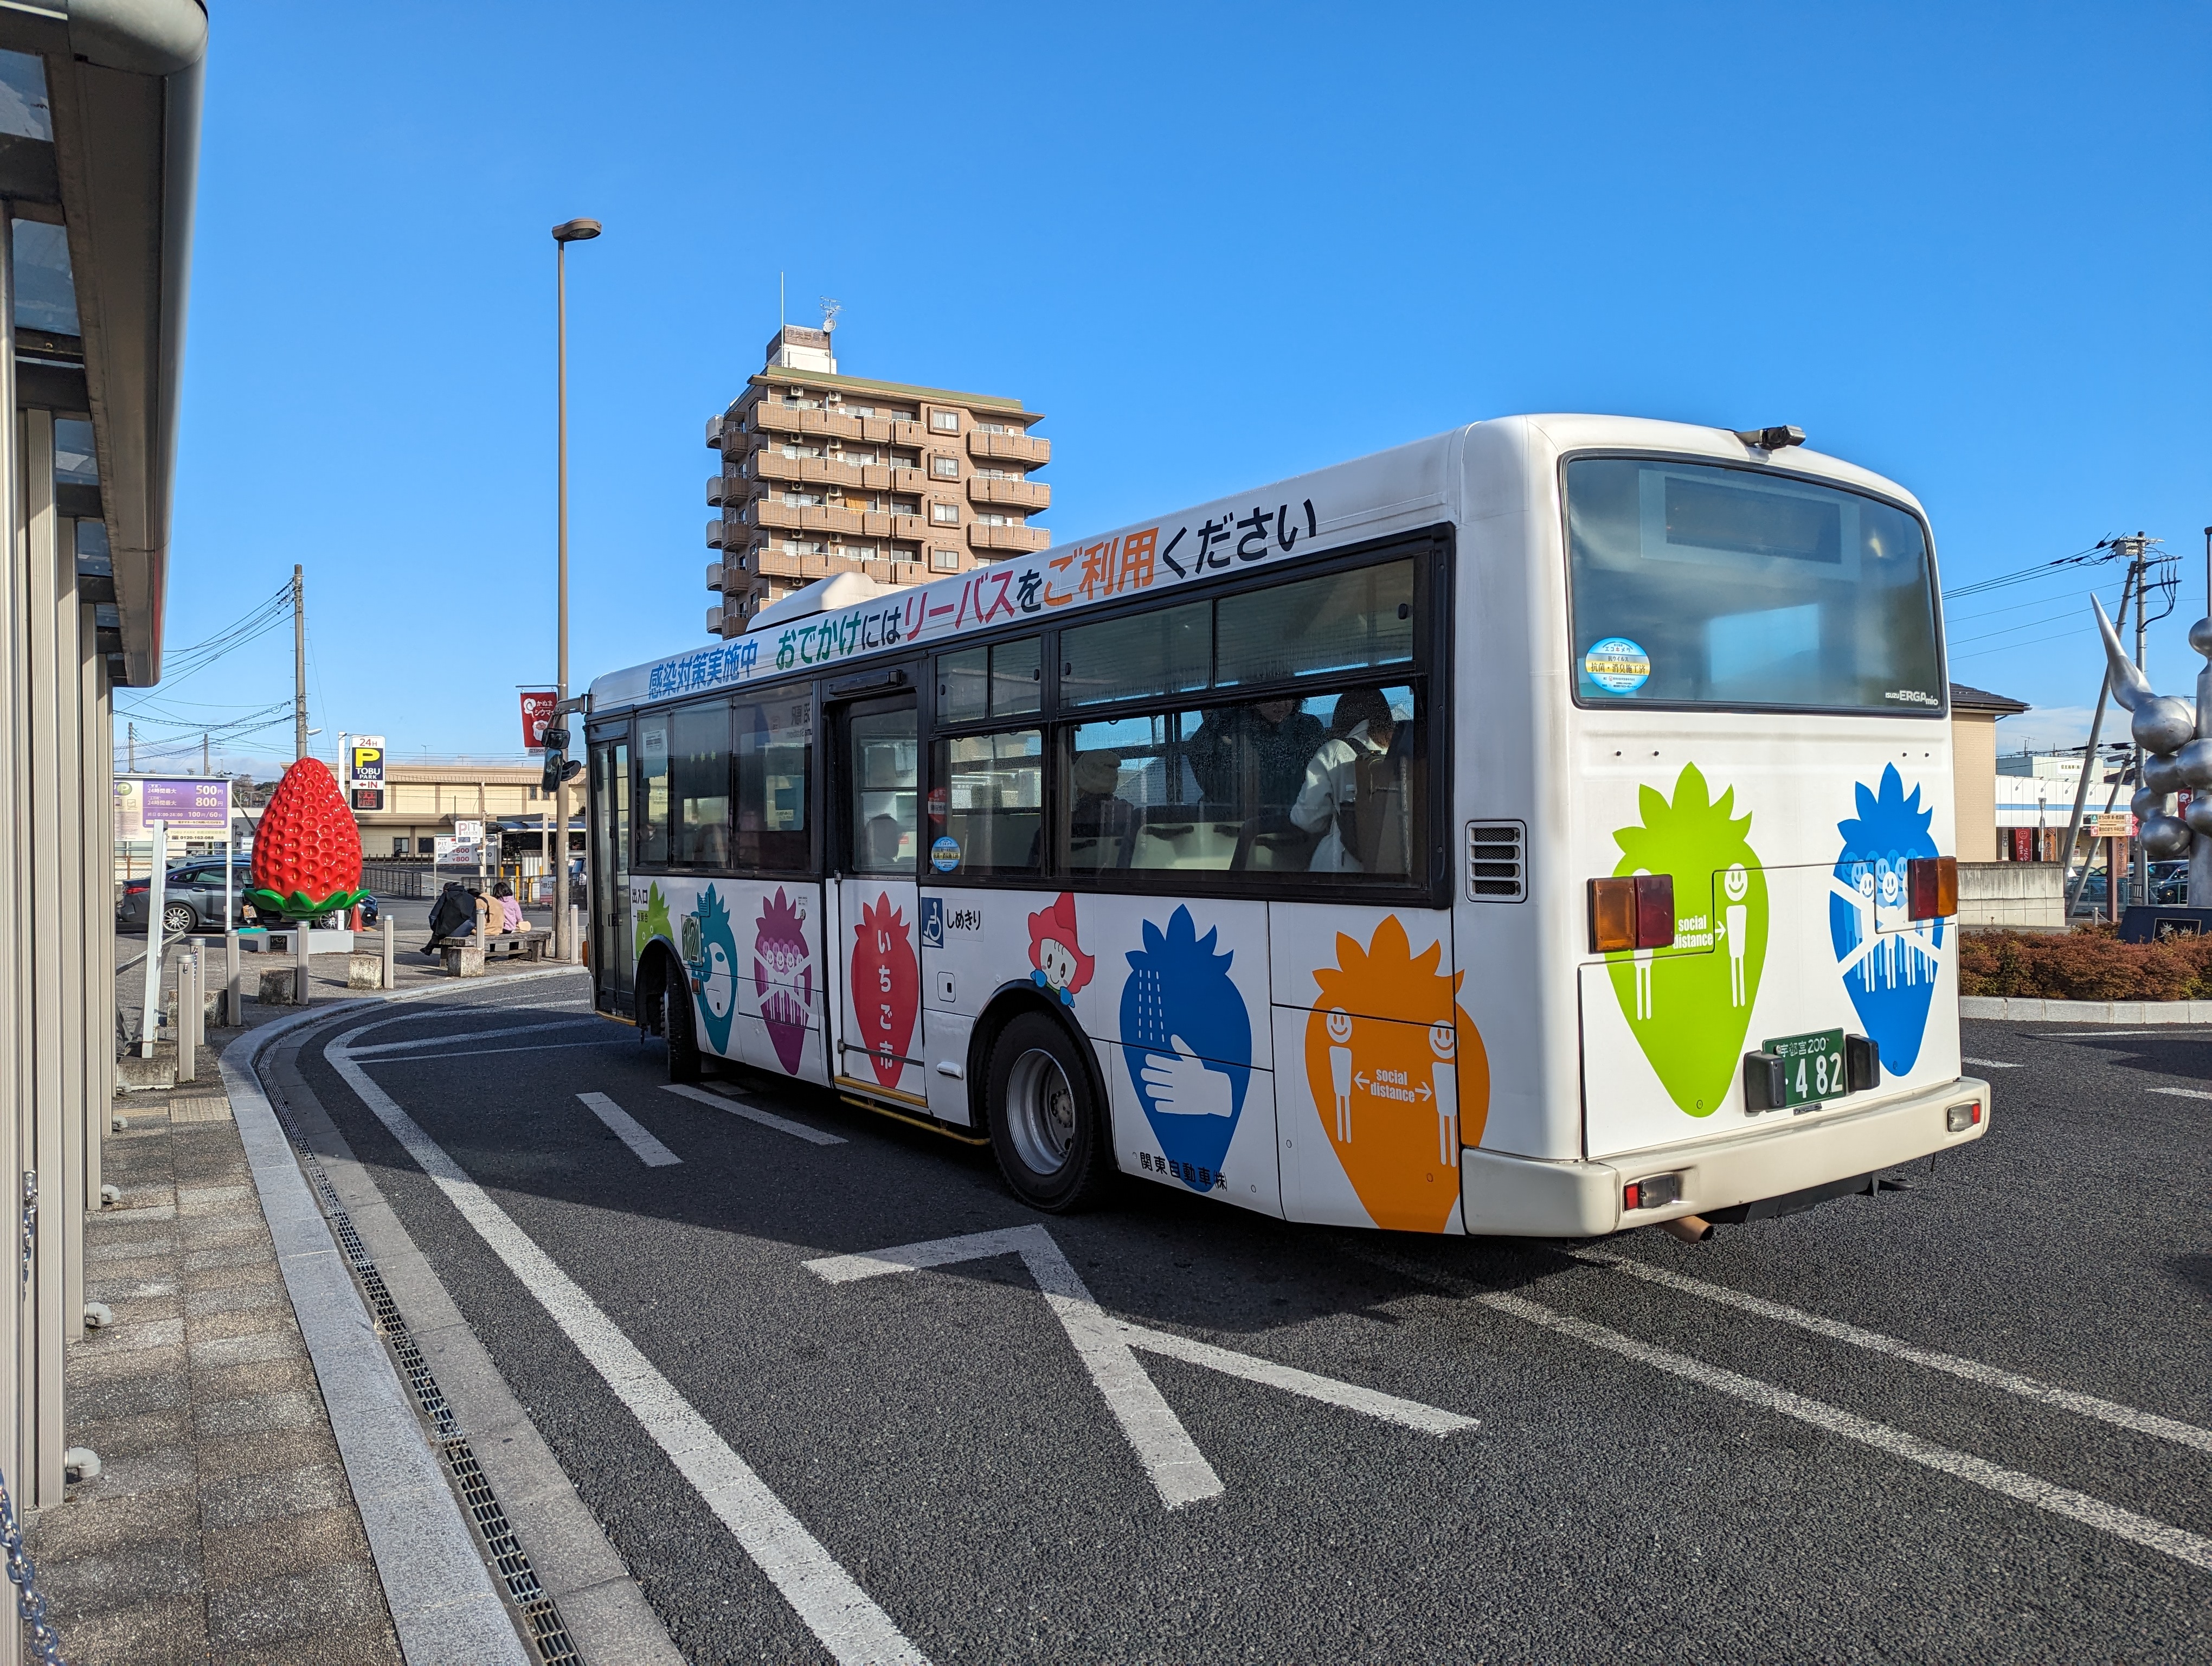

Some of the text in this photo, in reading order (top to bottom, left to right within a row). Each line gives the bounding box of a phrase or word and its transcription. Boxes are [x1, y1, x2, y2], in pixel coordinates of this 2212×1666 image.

[648, 638, 758, 700] 感染対策実施中
[1591, 662, 1646, 674] 抗菌・消臭施工済
[359, 738, 377, 747] 24H
[356, 748, 380, 767] P
[632, 888, 648, 905] 出入口
[947, 908, 981, 931] しめきり
[1678, 914, 1707, 932] social
[1672, 933, 1714, 950] distance
[1780, 1036, 1827, 1058] 宇都宮 200
[1376, 1069, 1408, 1086] social
[1370, 1081, 1416, 1103] distance
